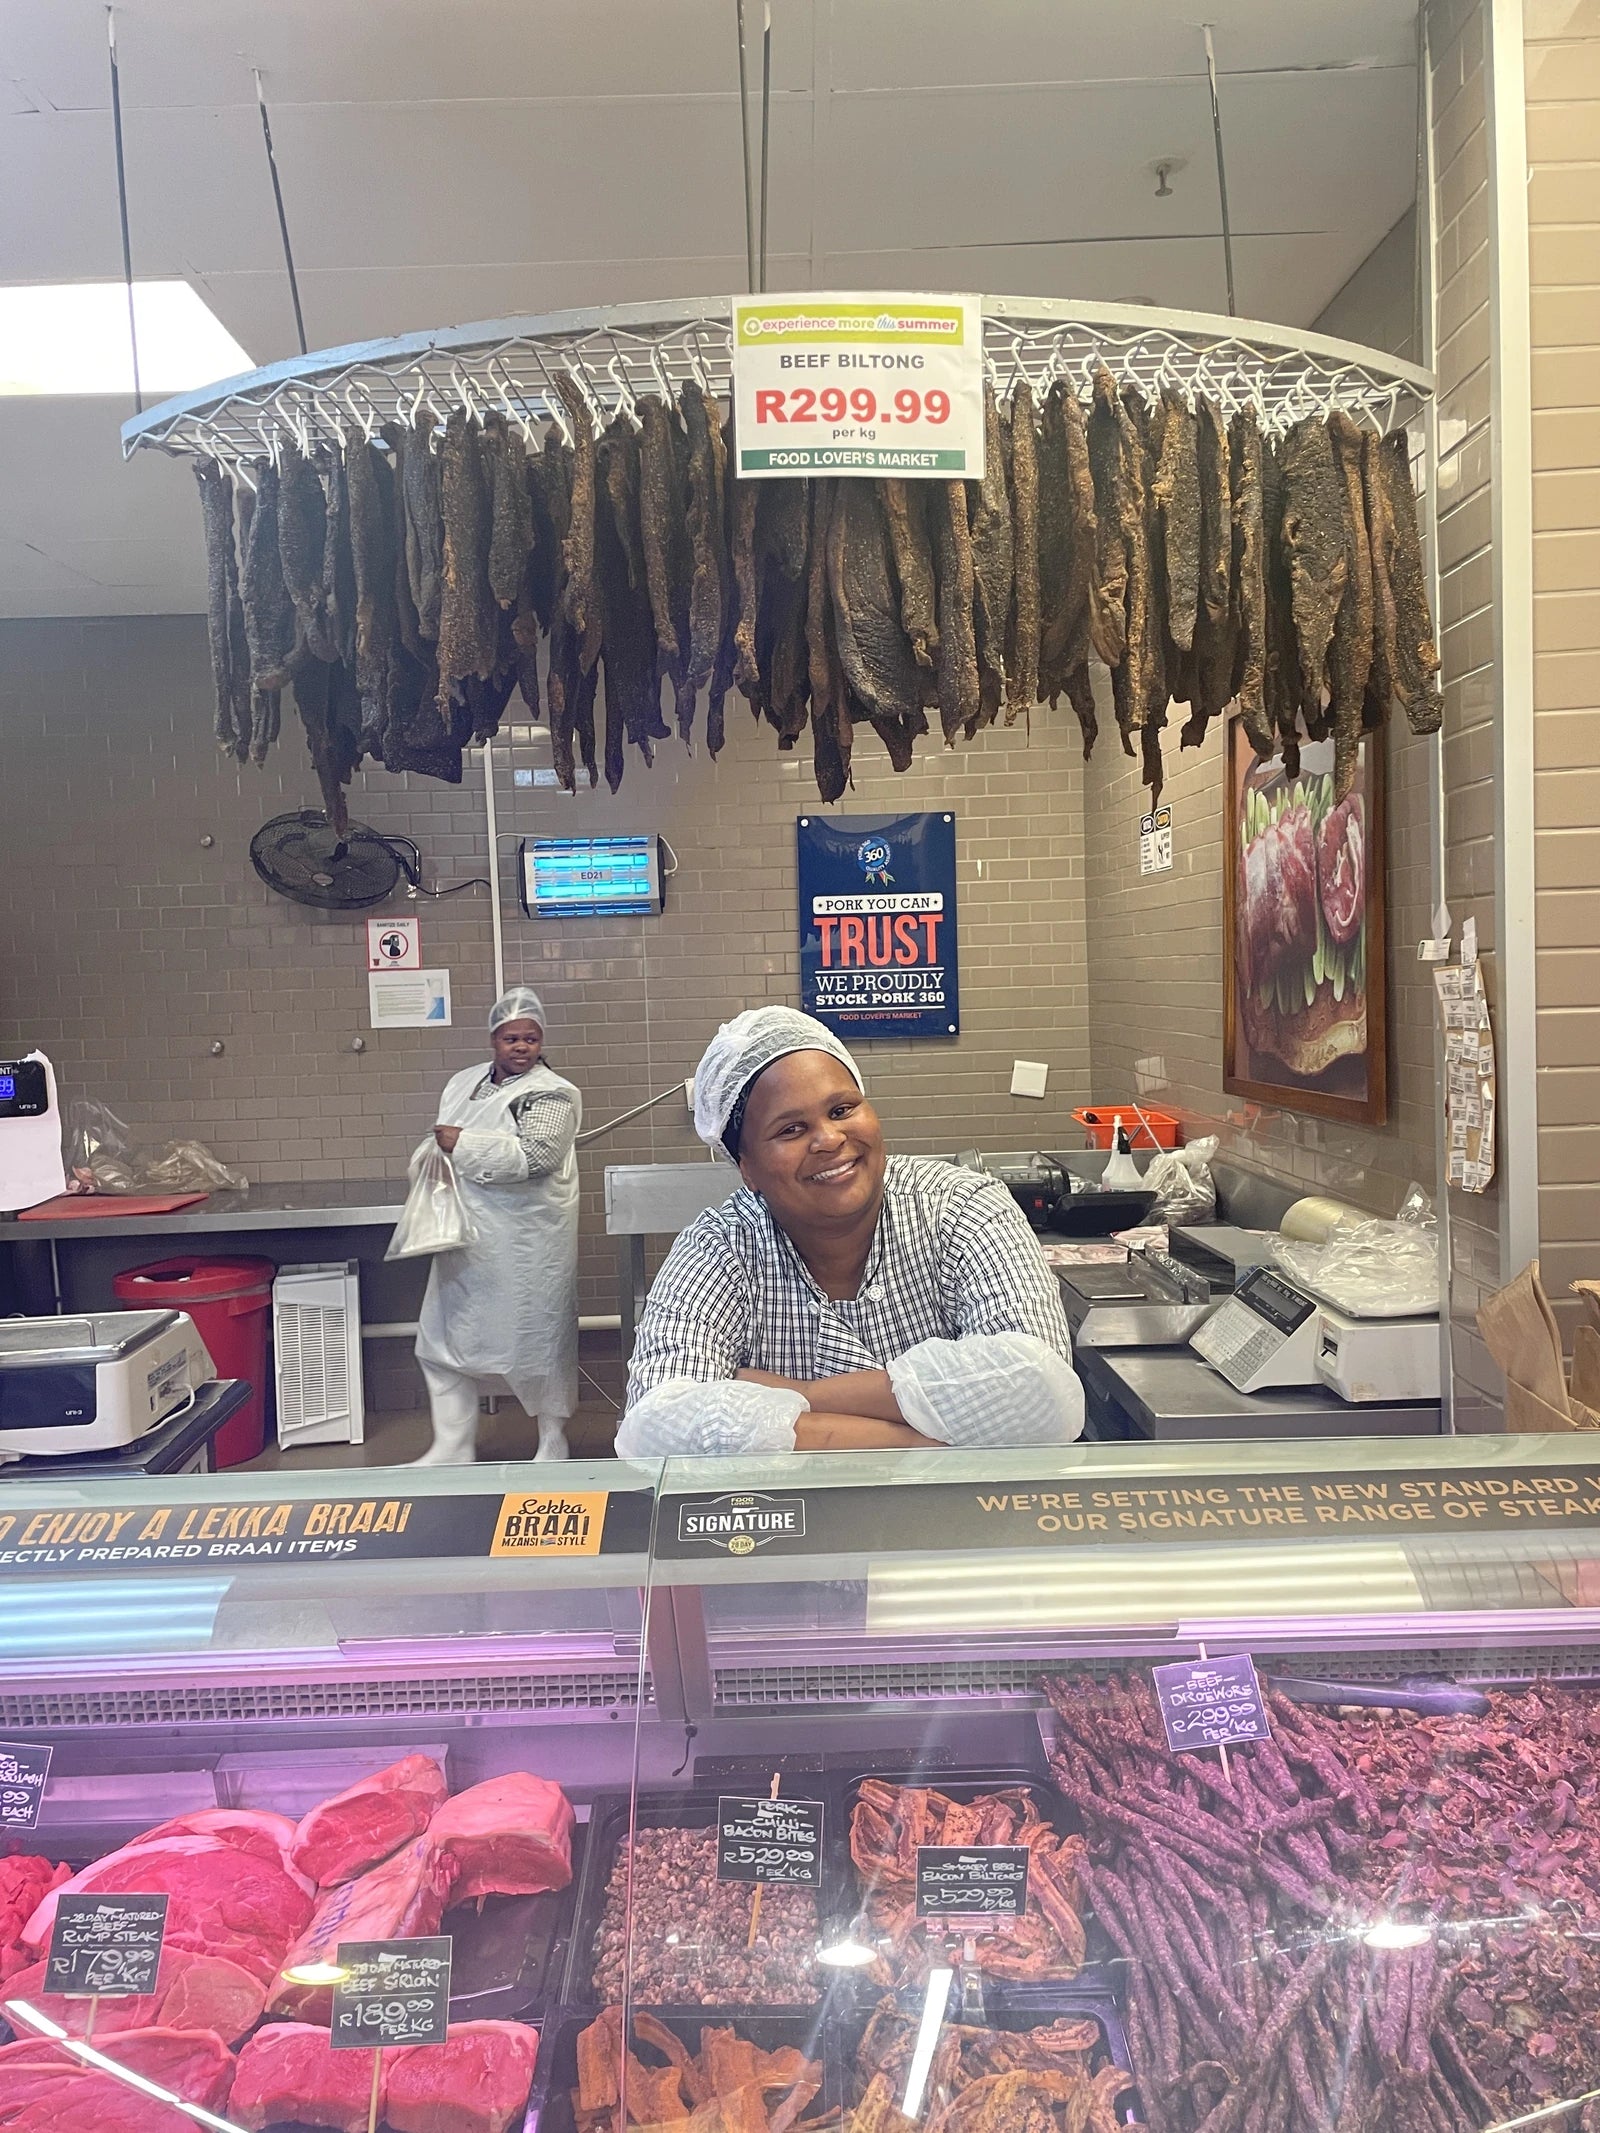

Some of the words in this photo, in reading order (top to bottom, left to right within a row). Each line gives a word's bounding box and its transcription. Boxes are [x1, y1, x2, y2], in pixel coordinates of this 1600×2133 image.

[762, 317, 836, 332] experience
[838, 319, 875, 329] more
[877, 316, 897, 330] this
[898, 319, 956, 331] summer
[780, 354, 831, 369] BEEF
[838, 354, 925, 369] BILTONG
[755, 388, 951, 425] R299.99
[832, 428, 855, 440] per
[859, 427, 876, 440] kg
[769, 452, 809, 466] FOOD
[814, 452, 875, 465] LOVER'S
[878, 453, 938, 466] MARKET
[864, 847, 884, 863] 360
[580, 871, 604, 881] ED21
[826, 898, 863, 911] PORK
[867, 898, 897, 910] YOU
[900, 897, 930, 909] CAN
[813, 914, 944, 967] TRUST
[815, 975, 848, 992] WE
[852, 972, 944, 991] PROUDLY
[816, 993, 868, 1006] STOCK
[872, 992, 914, 1004] PORK
[919, 991, 945, 1003] 360
[839, 1013, 860, 1021] FOOD
[892, 1011, 922, 1019] MARKET
[976, 1492, 1083, 1512] WE'RE
[1091, 1488, 1230, 1508] SETTING
[1236, 1486, 1304, 1503] THE
[1311, 1483, 1388, 1501] NEW
[1399, 1477, 1579, 1498] STANDARD
[518, 1499, 587, 1515] Lekka
[18, 1511, 136, 1546] ENJOY
[138, 1509, 172, 1541] A
[177, 1504, 293, 1540] LEKKA
[303, 1501, 412, 1536] BRAAI
[686, 1512, 796, 1533] SIGNATURE
[1037, 1513, 1109, 1532] OUR
[1118, 1506, 1308, 1530] SIGNATURE
[1314, 1502, 1436, 1523] RANGE
[1443, 1500, 1491, 1520] OF
[505, 1514, 590, 1537] BRAAI
[501, 1537, 538, 1547] MZANSI
[557, 1536, 587, 1546] STYLE
[0, 1548, 75, 1563] ECTLY
[77, 1544, 202, 1561] PREPARED
[207, 1541, 282, 1556] BRAAI
[288, 1539, 358, 1554] ITEMS
[1186, 1675, 1223, 1690] BEEF
[1202, 1727, 1231, 1740] PER
[2, 1804, 34, 1819] EACH
[758, 1801, 798, 1814] PORK
[723, 1824, 773, 1838] BACON
[789, 1867, 812, 1878] KG
[922, 1871, 964, 1882] BACON
[111, 1911, 160, 1921] MATURED
[91, 1921, 129, 1932] BEEF
[62, 1930, 111, 1943] RUMP
[112, 1931, 160, 1942] STEAK
[86, 1972, 116, 1985] PER
[380, 2022, 408, 2036] PER
[411, 2017, 434, 2032] KG
